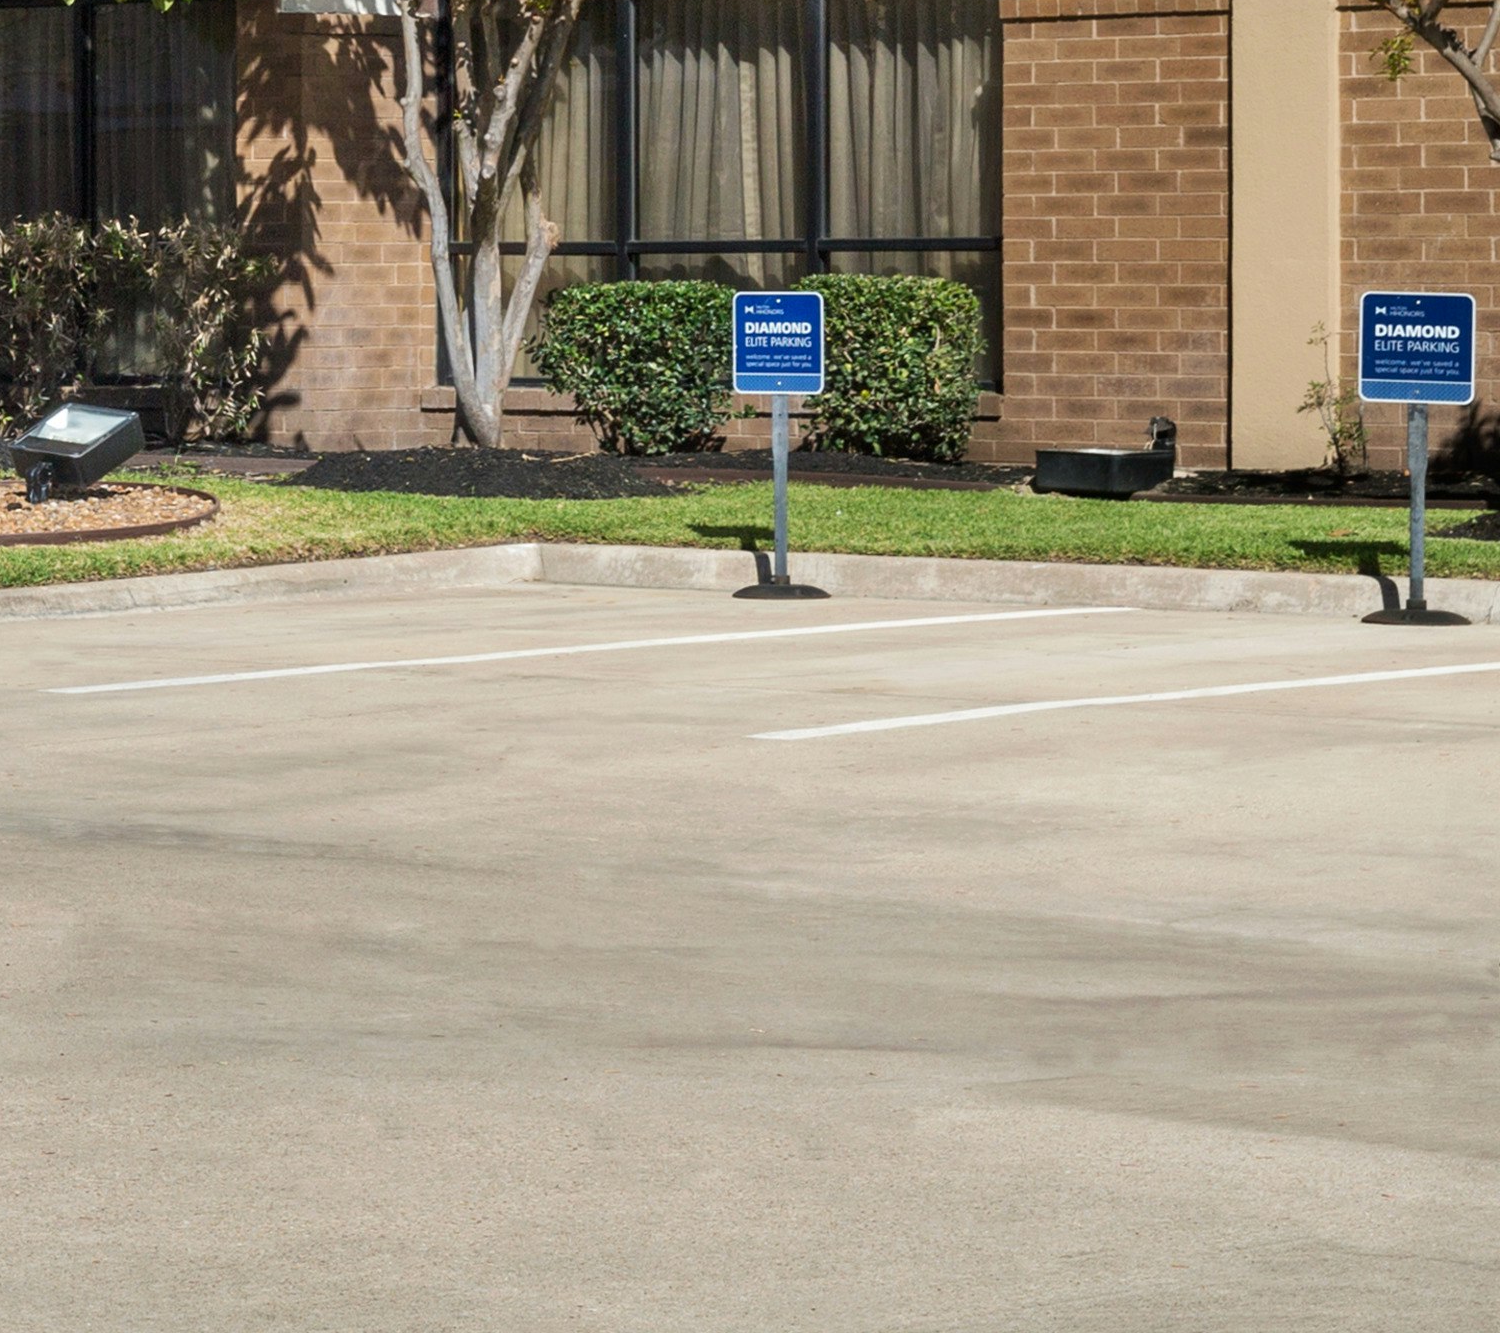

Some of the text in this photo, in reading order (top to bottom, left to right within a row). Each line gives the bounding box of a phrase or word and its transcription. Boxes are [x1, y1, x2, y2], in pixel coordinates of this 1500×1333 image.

[745, 322, 812, 334] DIAMOND
[1374, 324, 1460, 339] DIAMOND
[745, 336, 812, 347] ELITE PARKING
[1374, 339, 1460, 353] ELITE PARKING
